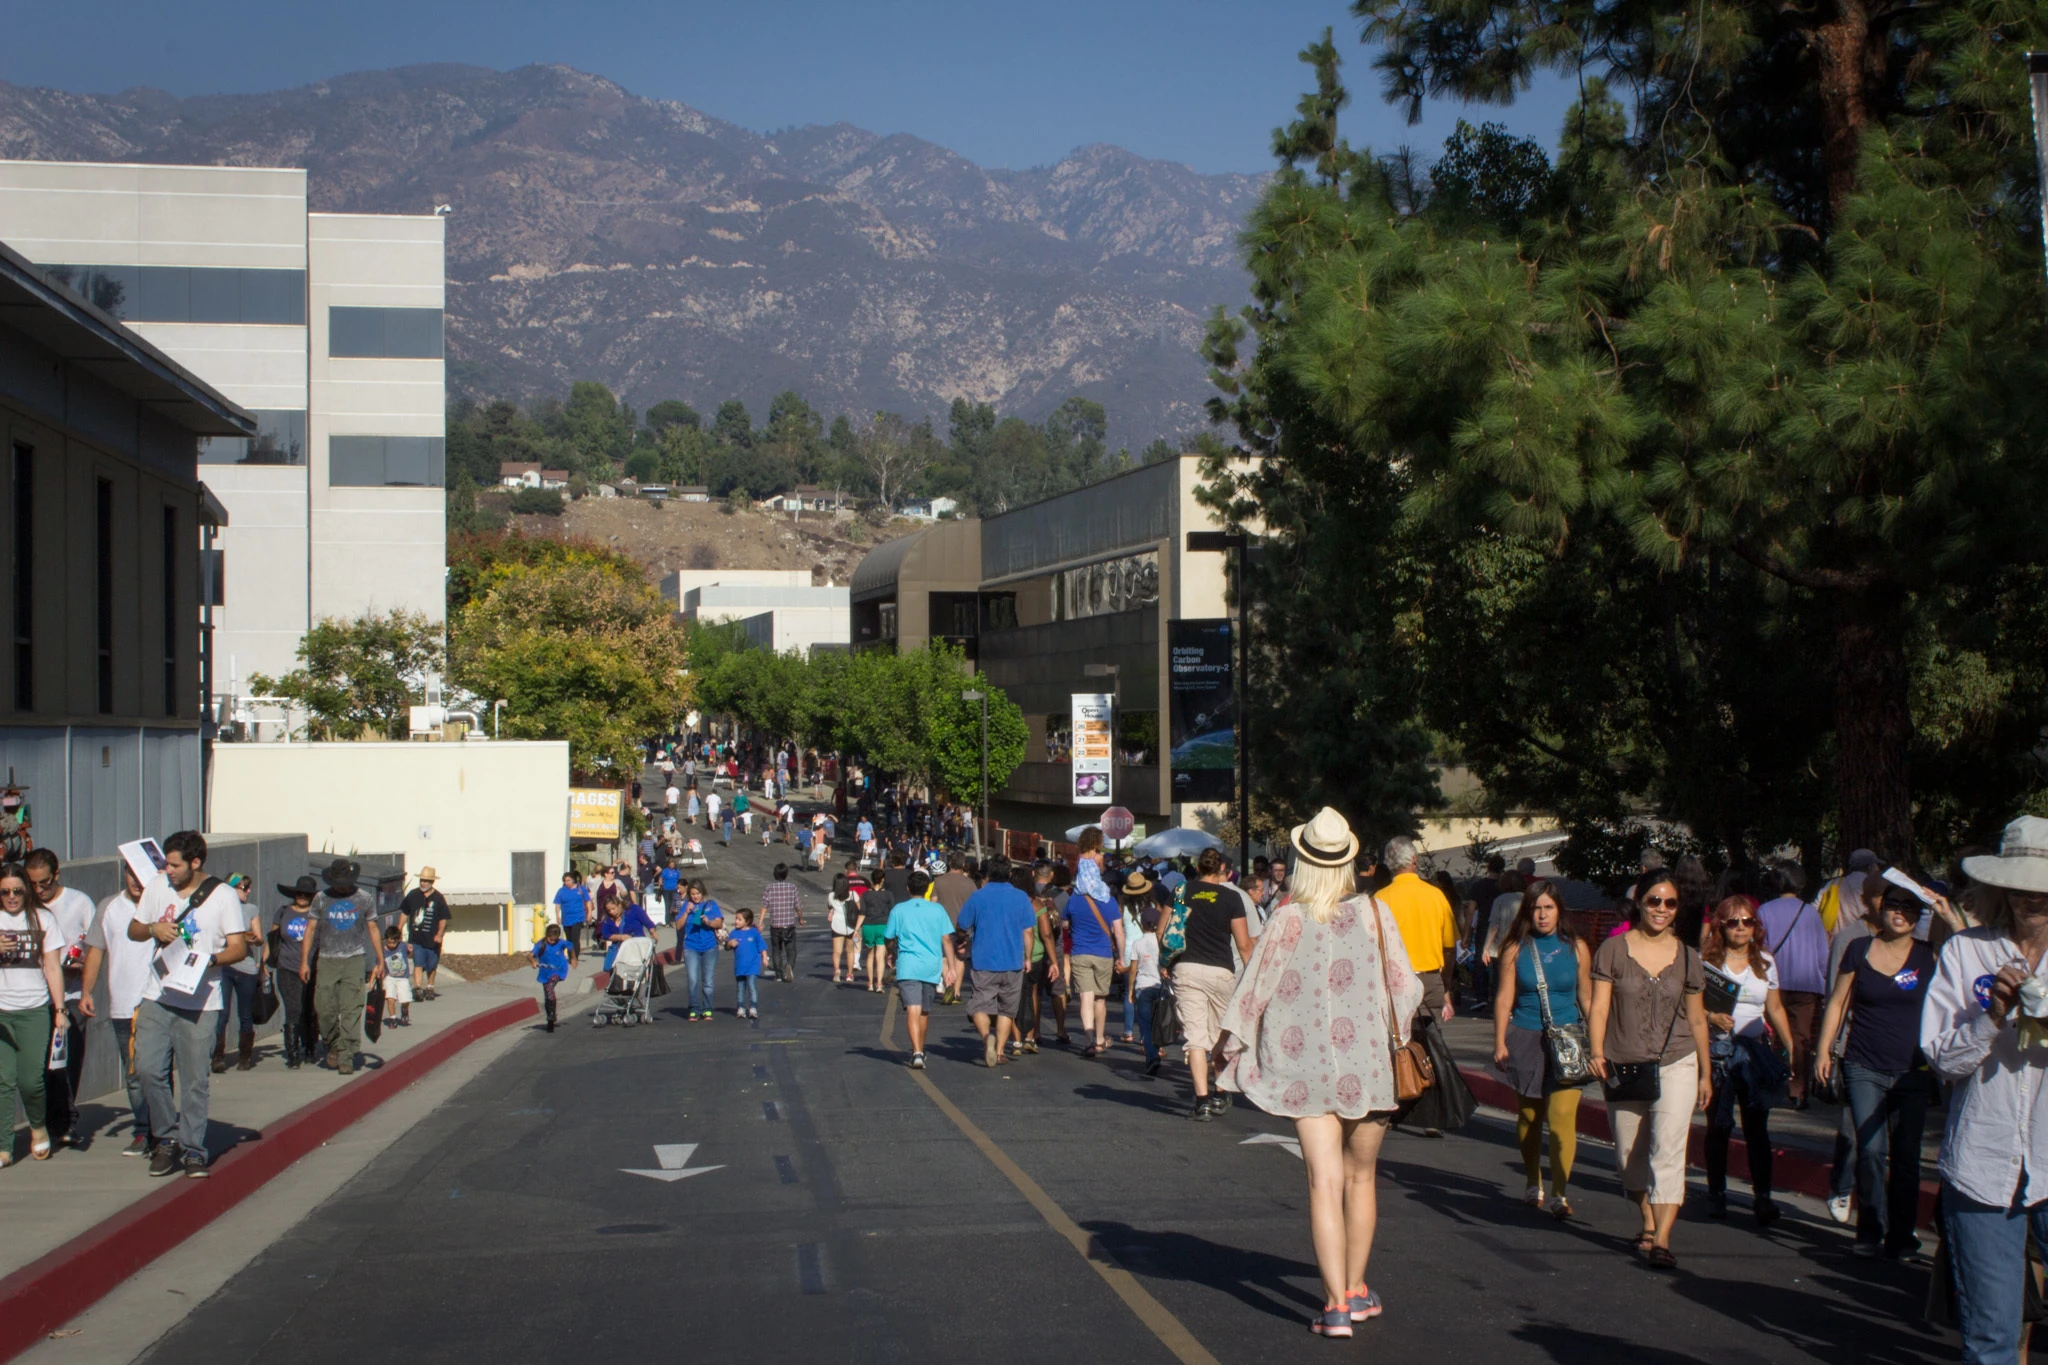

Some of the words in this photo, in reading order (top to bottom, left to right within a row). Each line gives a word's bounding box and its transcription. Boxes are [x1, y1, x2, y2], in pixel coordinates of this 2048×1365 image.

[1173, 647, 1204, 656] Orbiting
[1173, 656, 1201, 664] Carbon
[1173, 664, 1229, 673] Observatory-2
[1082, 707, 1099, 715] Open
[1103, 817, 1132, 830] STOP
[328, 911, 356, 920] NASA
[1895, 974, 1918, 984] NASA
[1975, 983, 1991, 997] NA
